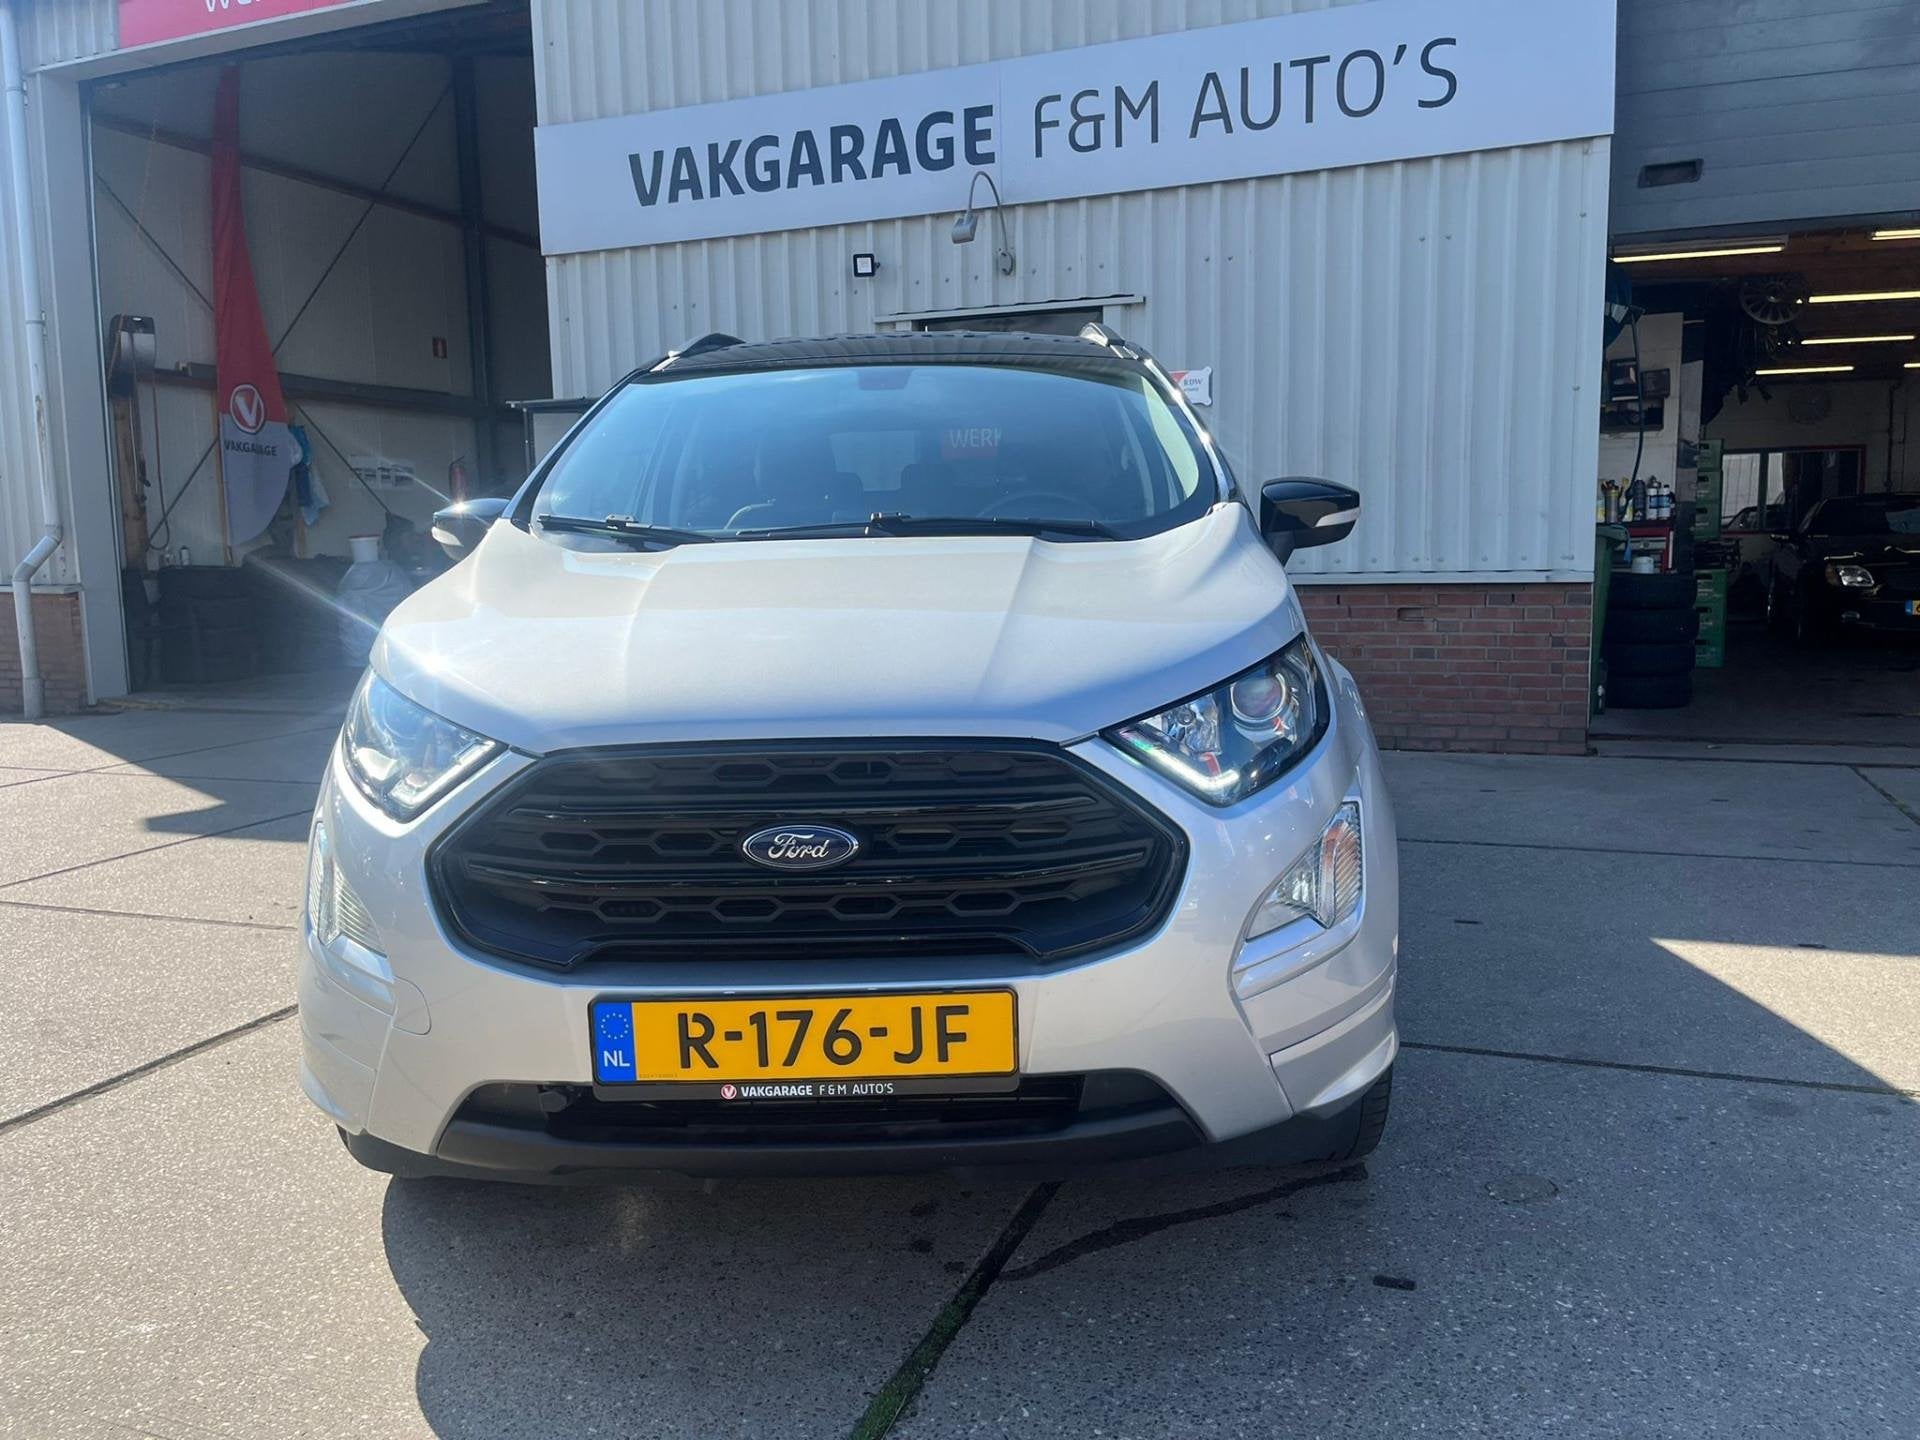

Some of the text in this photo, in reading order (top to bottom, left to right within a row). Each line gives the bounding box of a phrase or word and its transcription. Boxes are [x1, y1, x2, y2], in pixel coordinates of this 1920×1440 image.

[628, 37, 1457, 207] VAKGARAGE F&M AUTO'S
[767, 832, 831, 859] Ford
[676, 1004, 971, 1069] R-176-JF
[603, 1050, 631, 1068] NL
[740, 1084, 813, 1097] VAKGARAGE
[852, 1082, 894, 1095] AUTO'S
